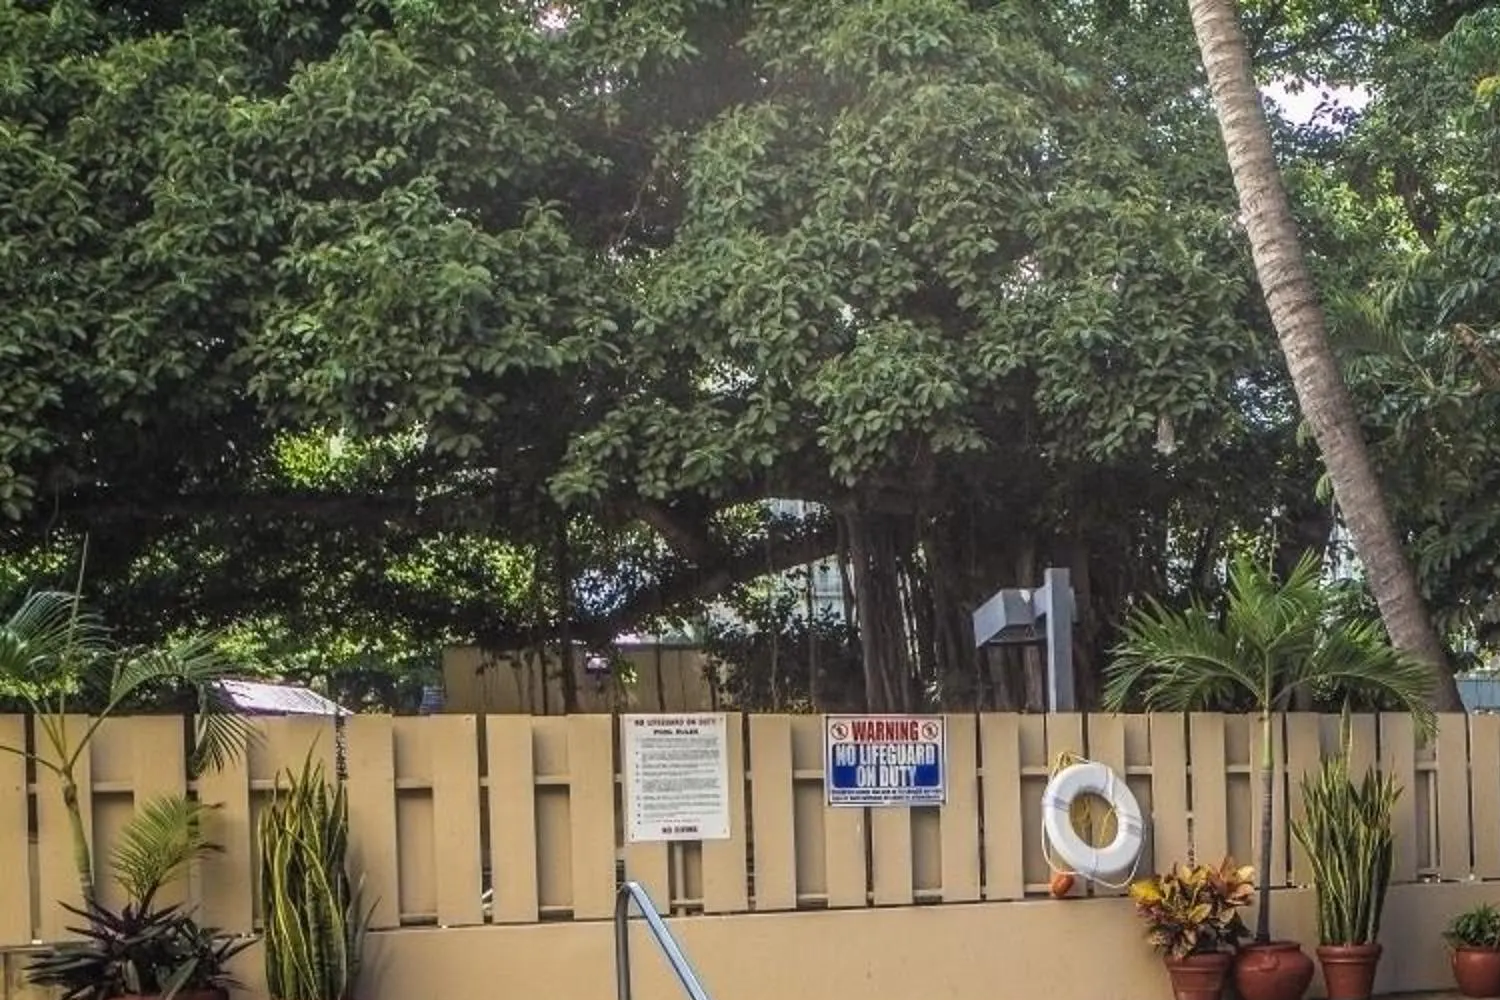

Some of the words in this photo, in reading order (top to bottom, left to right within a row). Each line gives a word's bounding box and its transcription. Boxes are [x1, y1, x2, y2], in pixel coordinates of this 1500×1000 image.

[851, 720, 919, 741] WARNING
[835, 744, 857, 766] NO
[860, 743, 935, 766] LIFEGUARD
[856, 765, 876, 788] ON
[879, 765, 917, 787] DUTY
